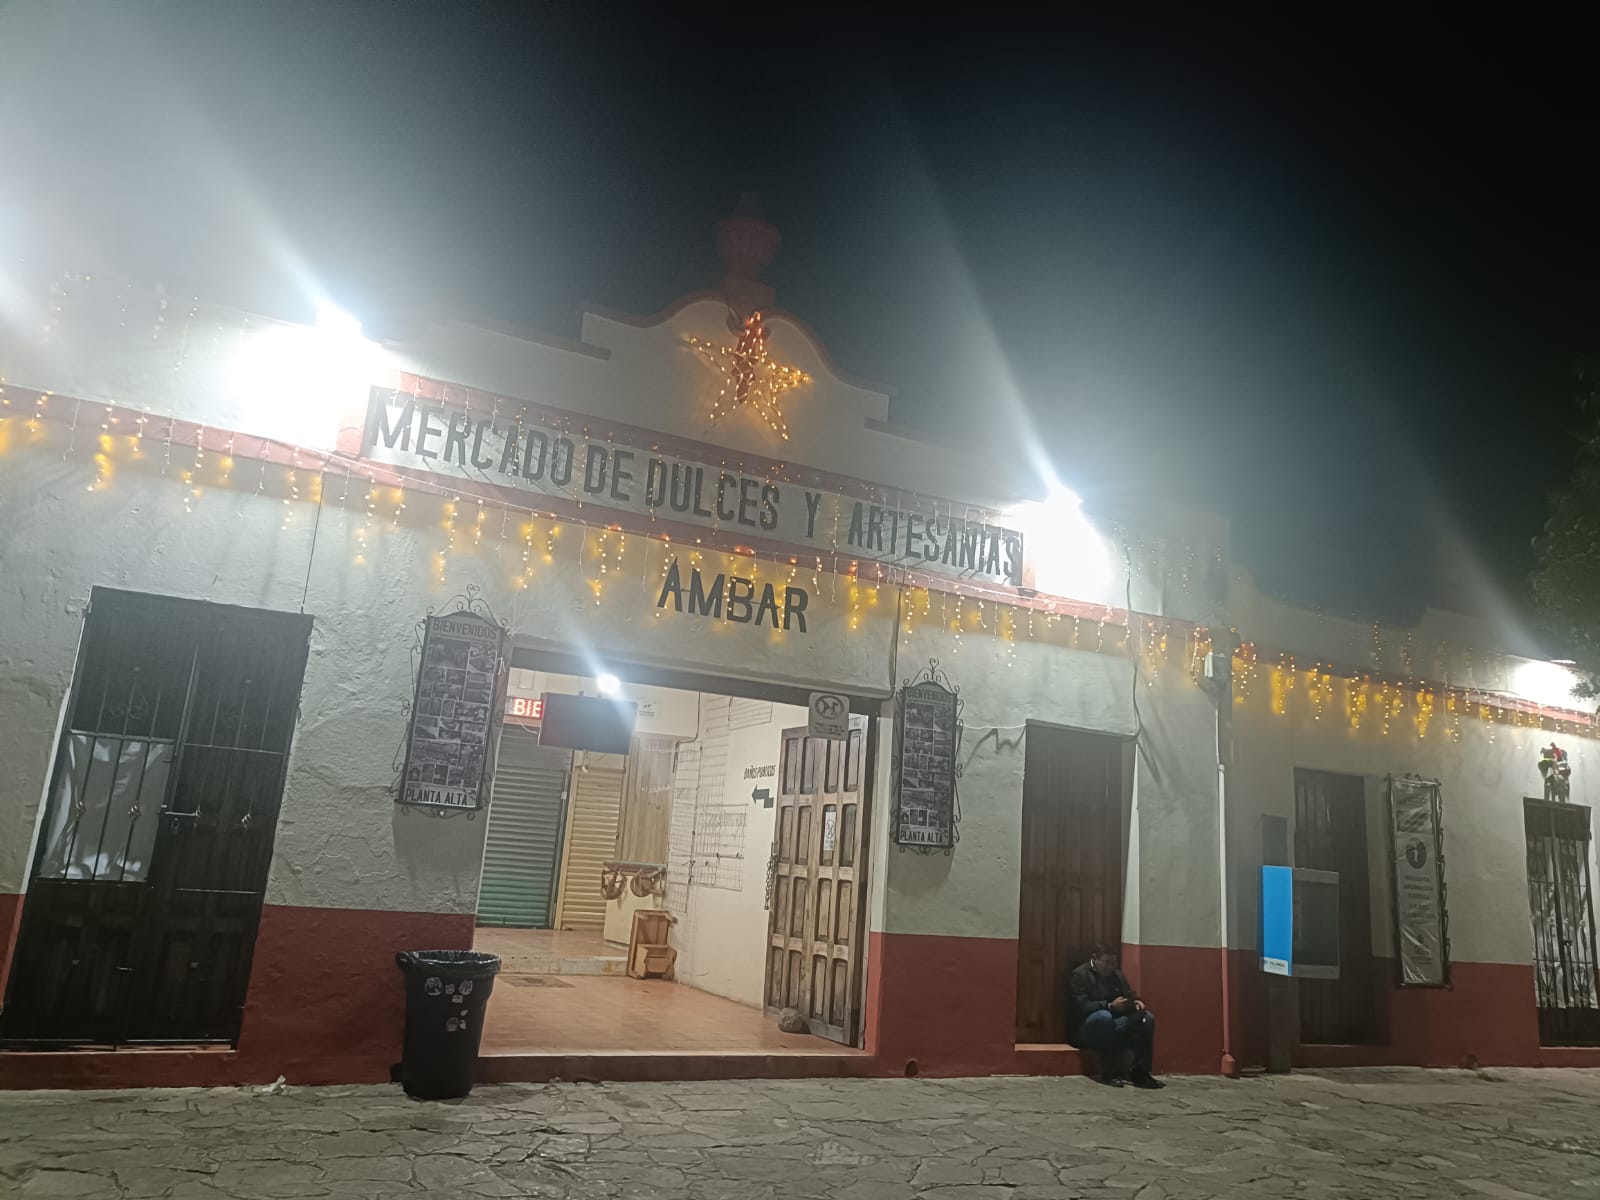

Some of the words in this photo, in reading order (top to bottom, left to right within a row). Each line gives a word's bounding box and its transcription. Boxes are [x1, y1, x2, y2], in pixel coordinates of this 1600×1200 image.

[370, 390, 573, 486] MERCADO
[583, 443, 633, 501] DE
[646, 458, 779, 529] DULCES
[805, 491, 821, 538] Y
[656, 556, 809, 632] AMBAR
[433, 619, 496, 639] BIENVENIDOS
[405, 788, 440, 803] PLANTA
[444, 792, 467, 805] ALTA
[901, 830, 925, 842] PLANTA
[927, 832, 943, 844] ALTA
